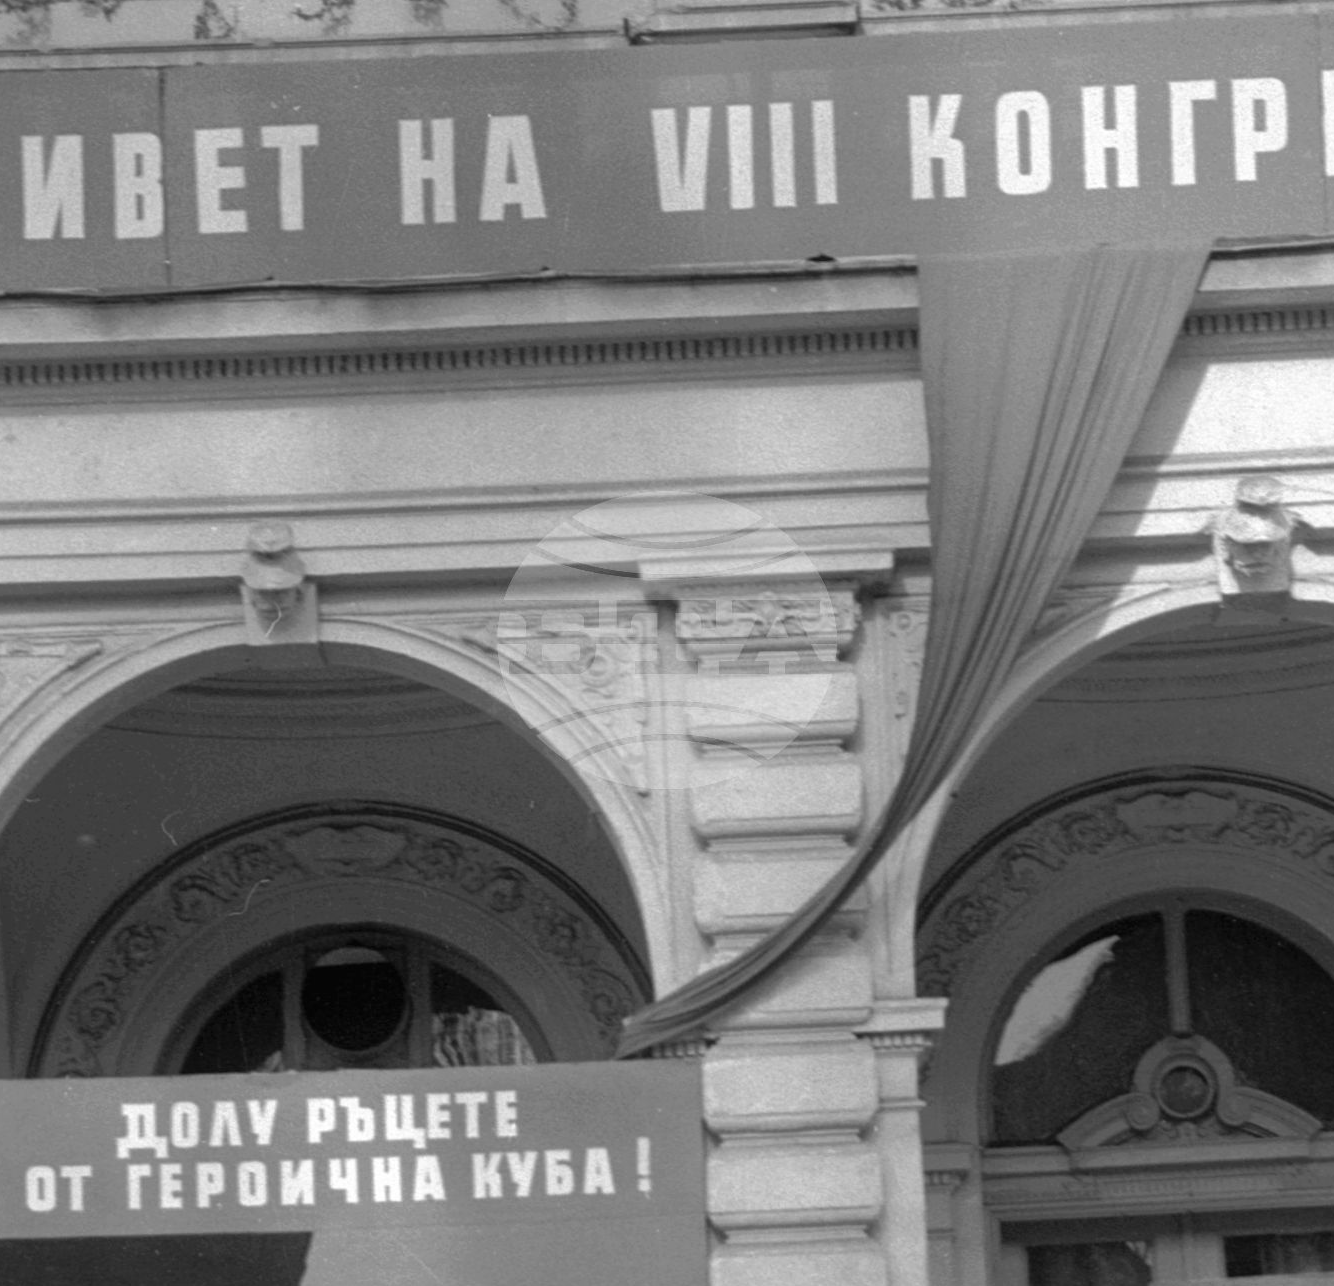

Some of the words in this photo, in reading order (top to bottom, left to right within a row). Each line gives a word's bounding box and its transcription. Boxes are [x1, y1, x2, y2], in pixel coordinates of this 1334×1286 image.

[399, 115, 547, 226] НА
[650, 99, 838, 212] VIII
[116, 1099, 277, 1158] ДОЛУ
[307, 1090, 518, 1149] РЪЦЕТЕ
[25, 1165, 92, 1211] ОТ
[127, 1155, 447, 1210] ГЕРОИЧНА
